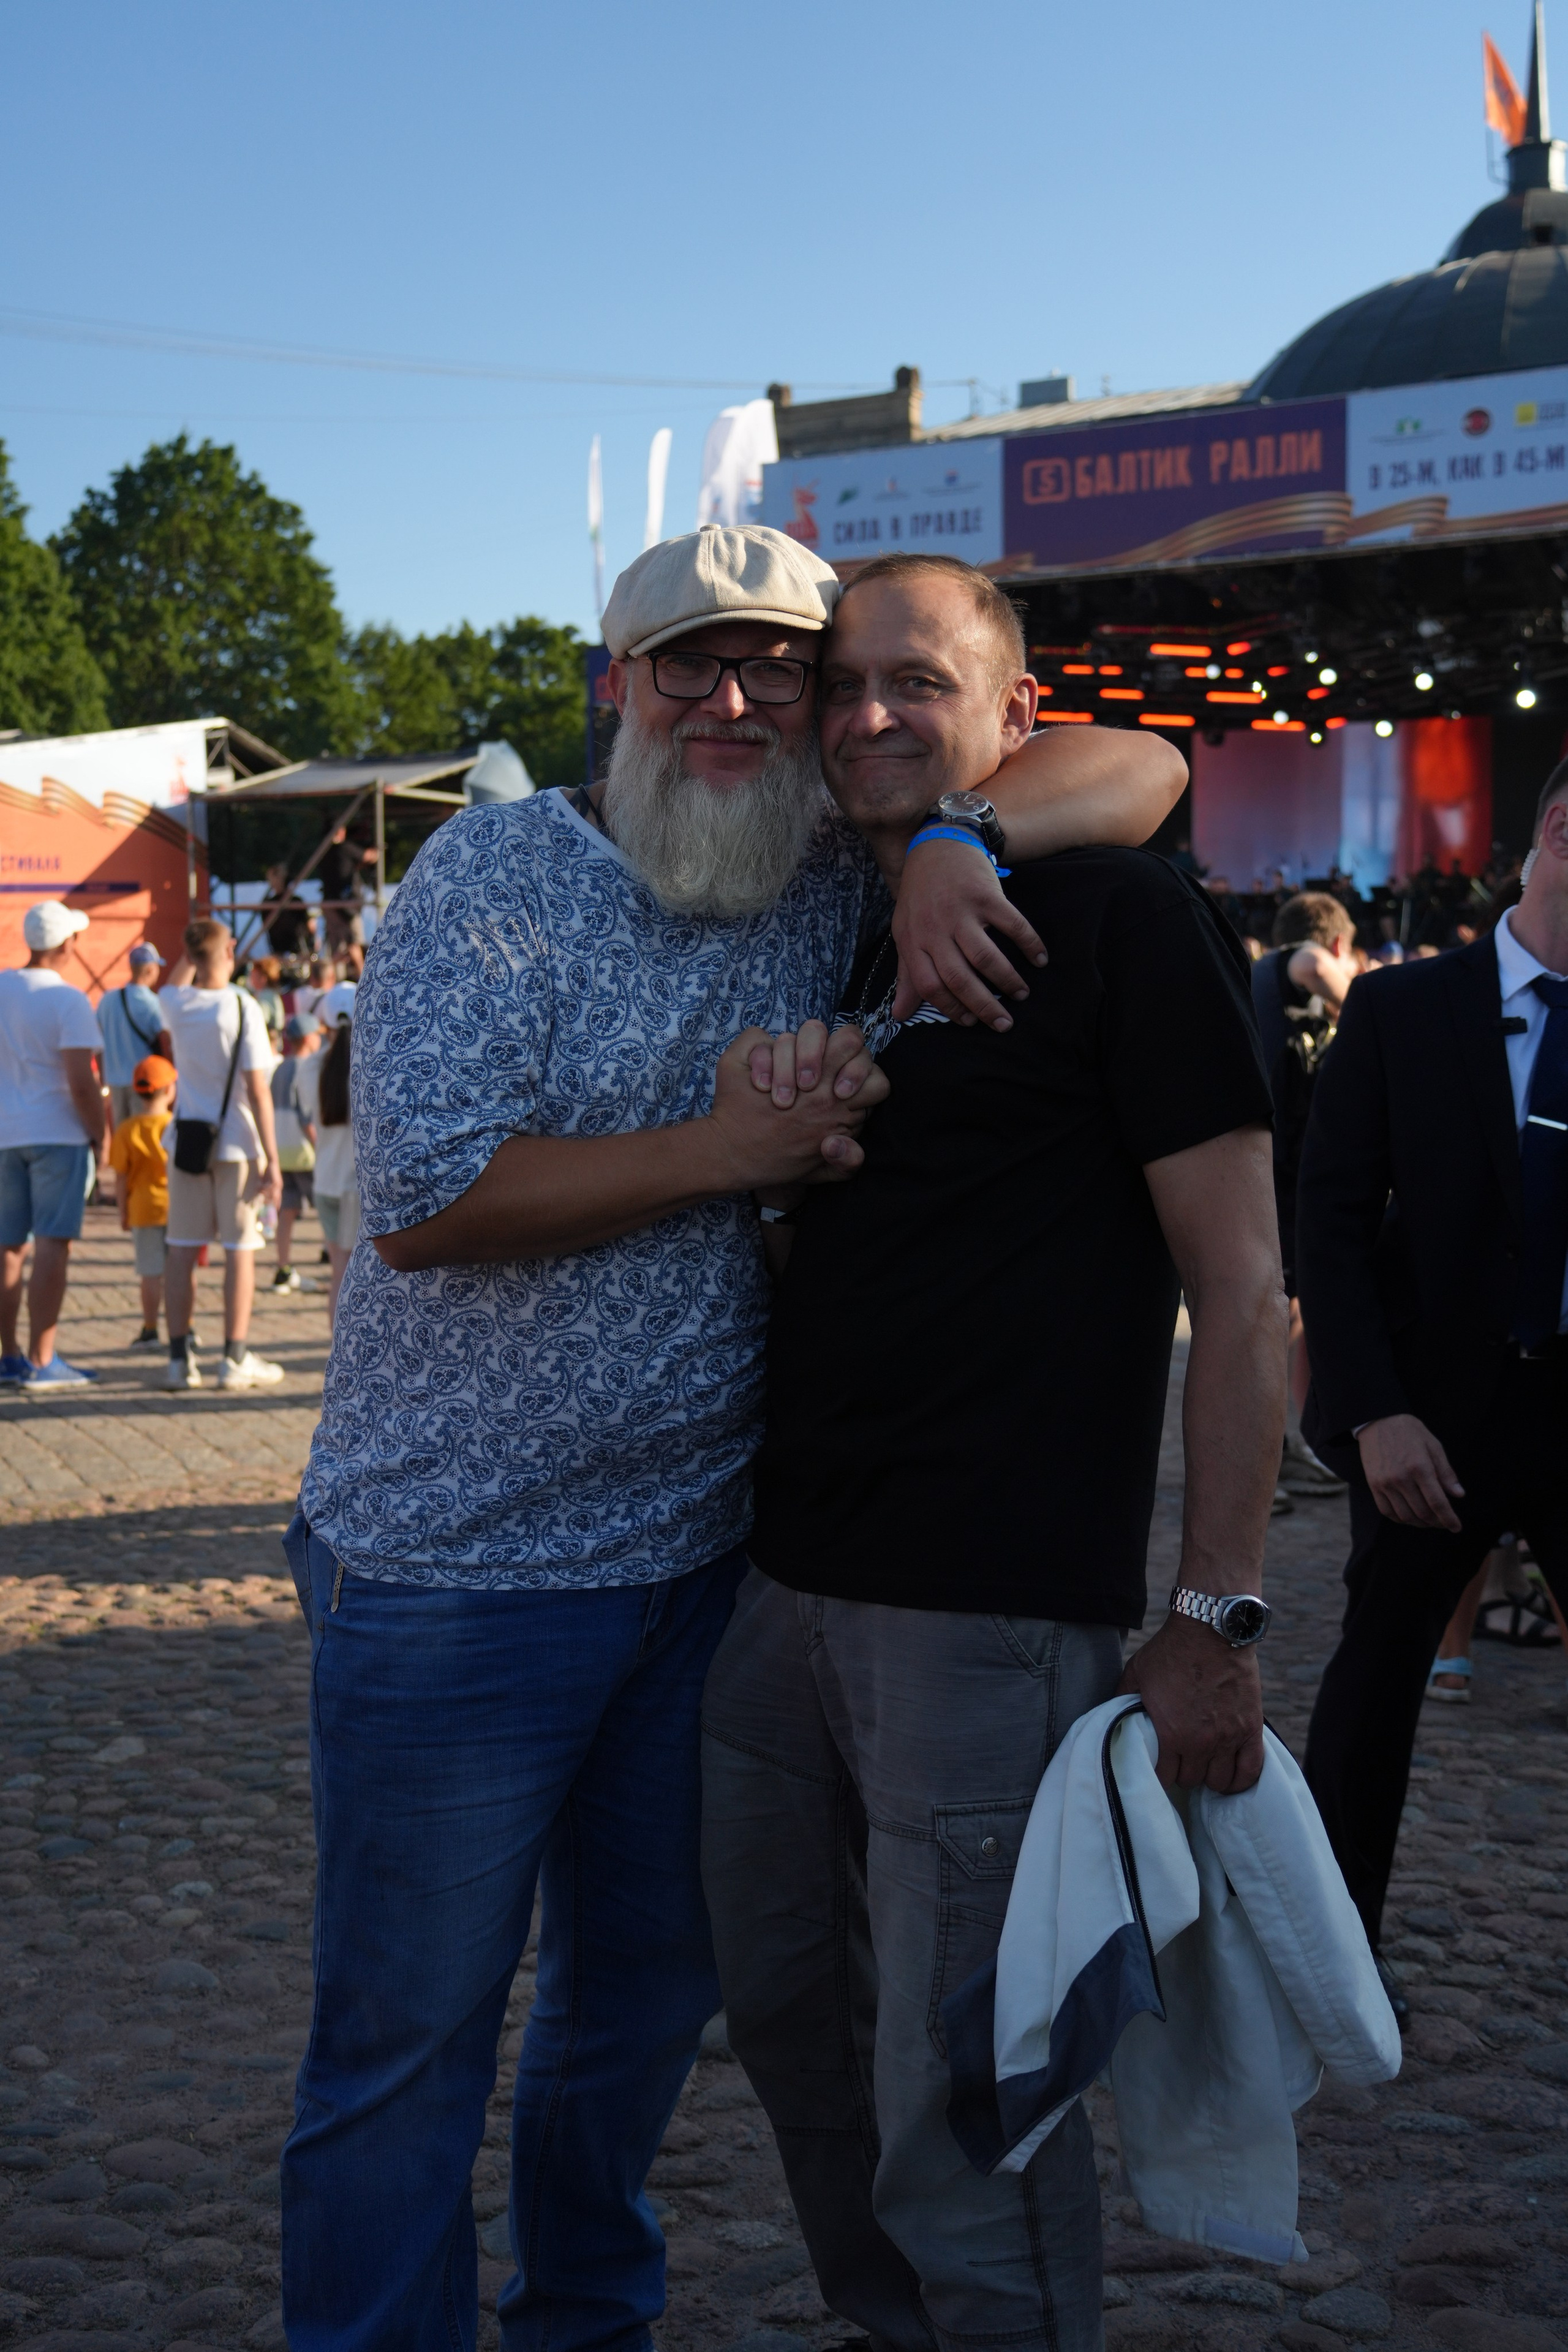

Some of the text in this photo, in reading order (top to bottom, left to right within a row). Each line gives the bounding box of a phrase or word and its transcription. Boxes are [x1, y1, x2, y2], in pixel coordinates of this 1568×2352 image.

[1074, 429, 1322, 498] БАЛТИК РАЛЛИ
[1369, 464, 1381, 490] В
[1447, 453, 1483, 481] КАК
[1493, 450, 1505, 477] В
[833, 520, 879, 546] СИЛА
[890, 516, 902, 541] В
[910, 507, 982, 538] ПРАВДЕ
